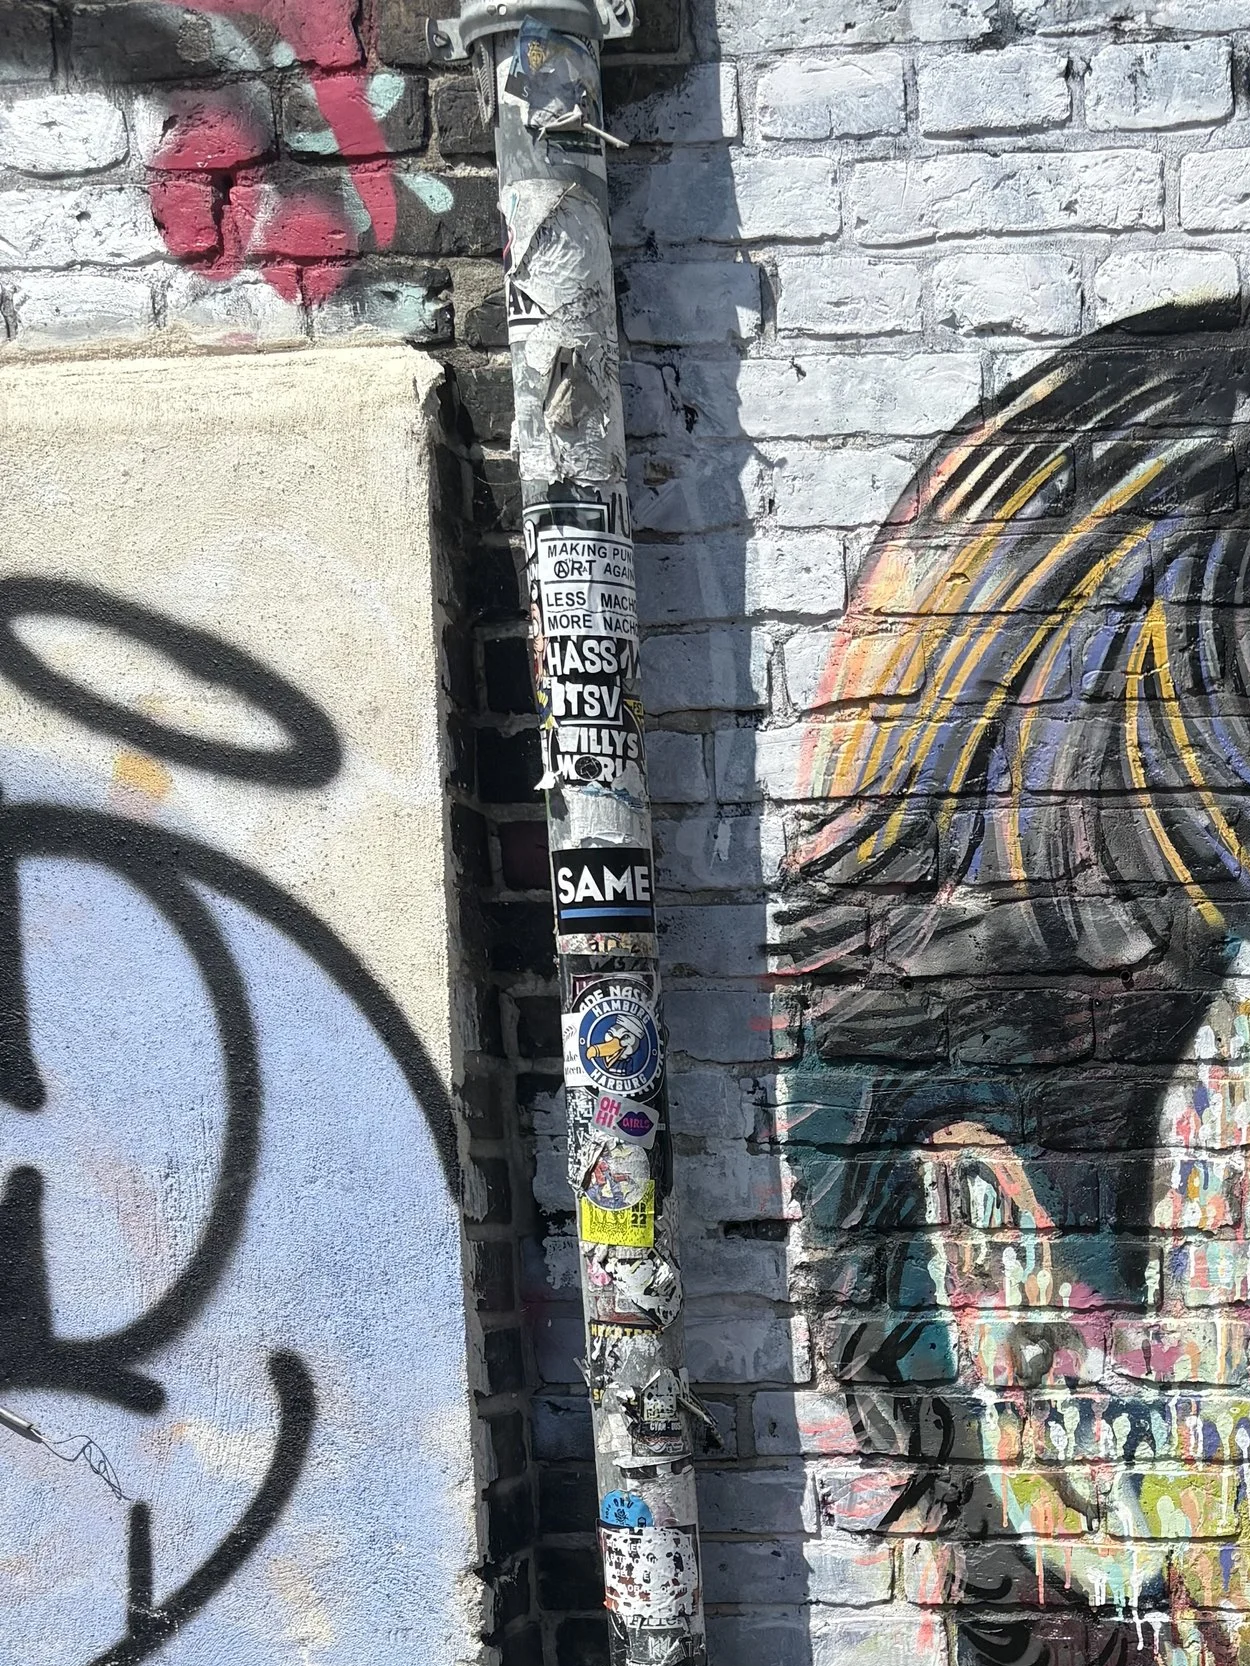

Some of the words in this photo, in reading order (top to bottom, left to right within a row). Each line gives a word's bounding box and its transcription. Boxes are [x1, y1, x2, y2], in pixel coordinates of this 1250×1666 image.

[548, 543, 607, 558] MAKING
[546, 591, 586, 607] LESS
[548, 614, 592, 631] MORE
[547, 639, 619, 676] HASS
[556, 726, 638, 759] WILLYS
[558, 865, 651, 904] SAME
[592, 1000, 652, 1024] HAMBURG
[590, 1069, 648, 1091] HARBURG
[622, 1117, 650, 1129] GIRLS
